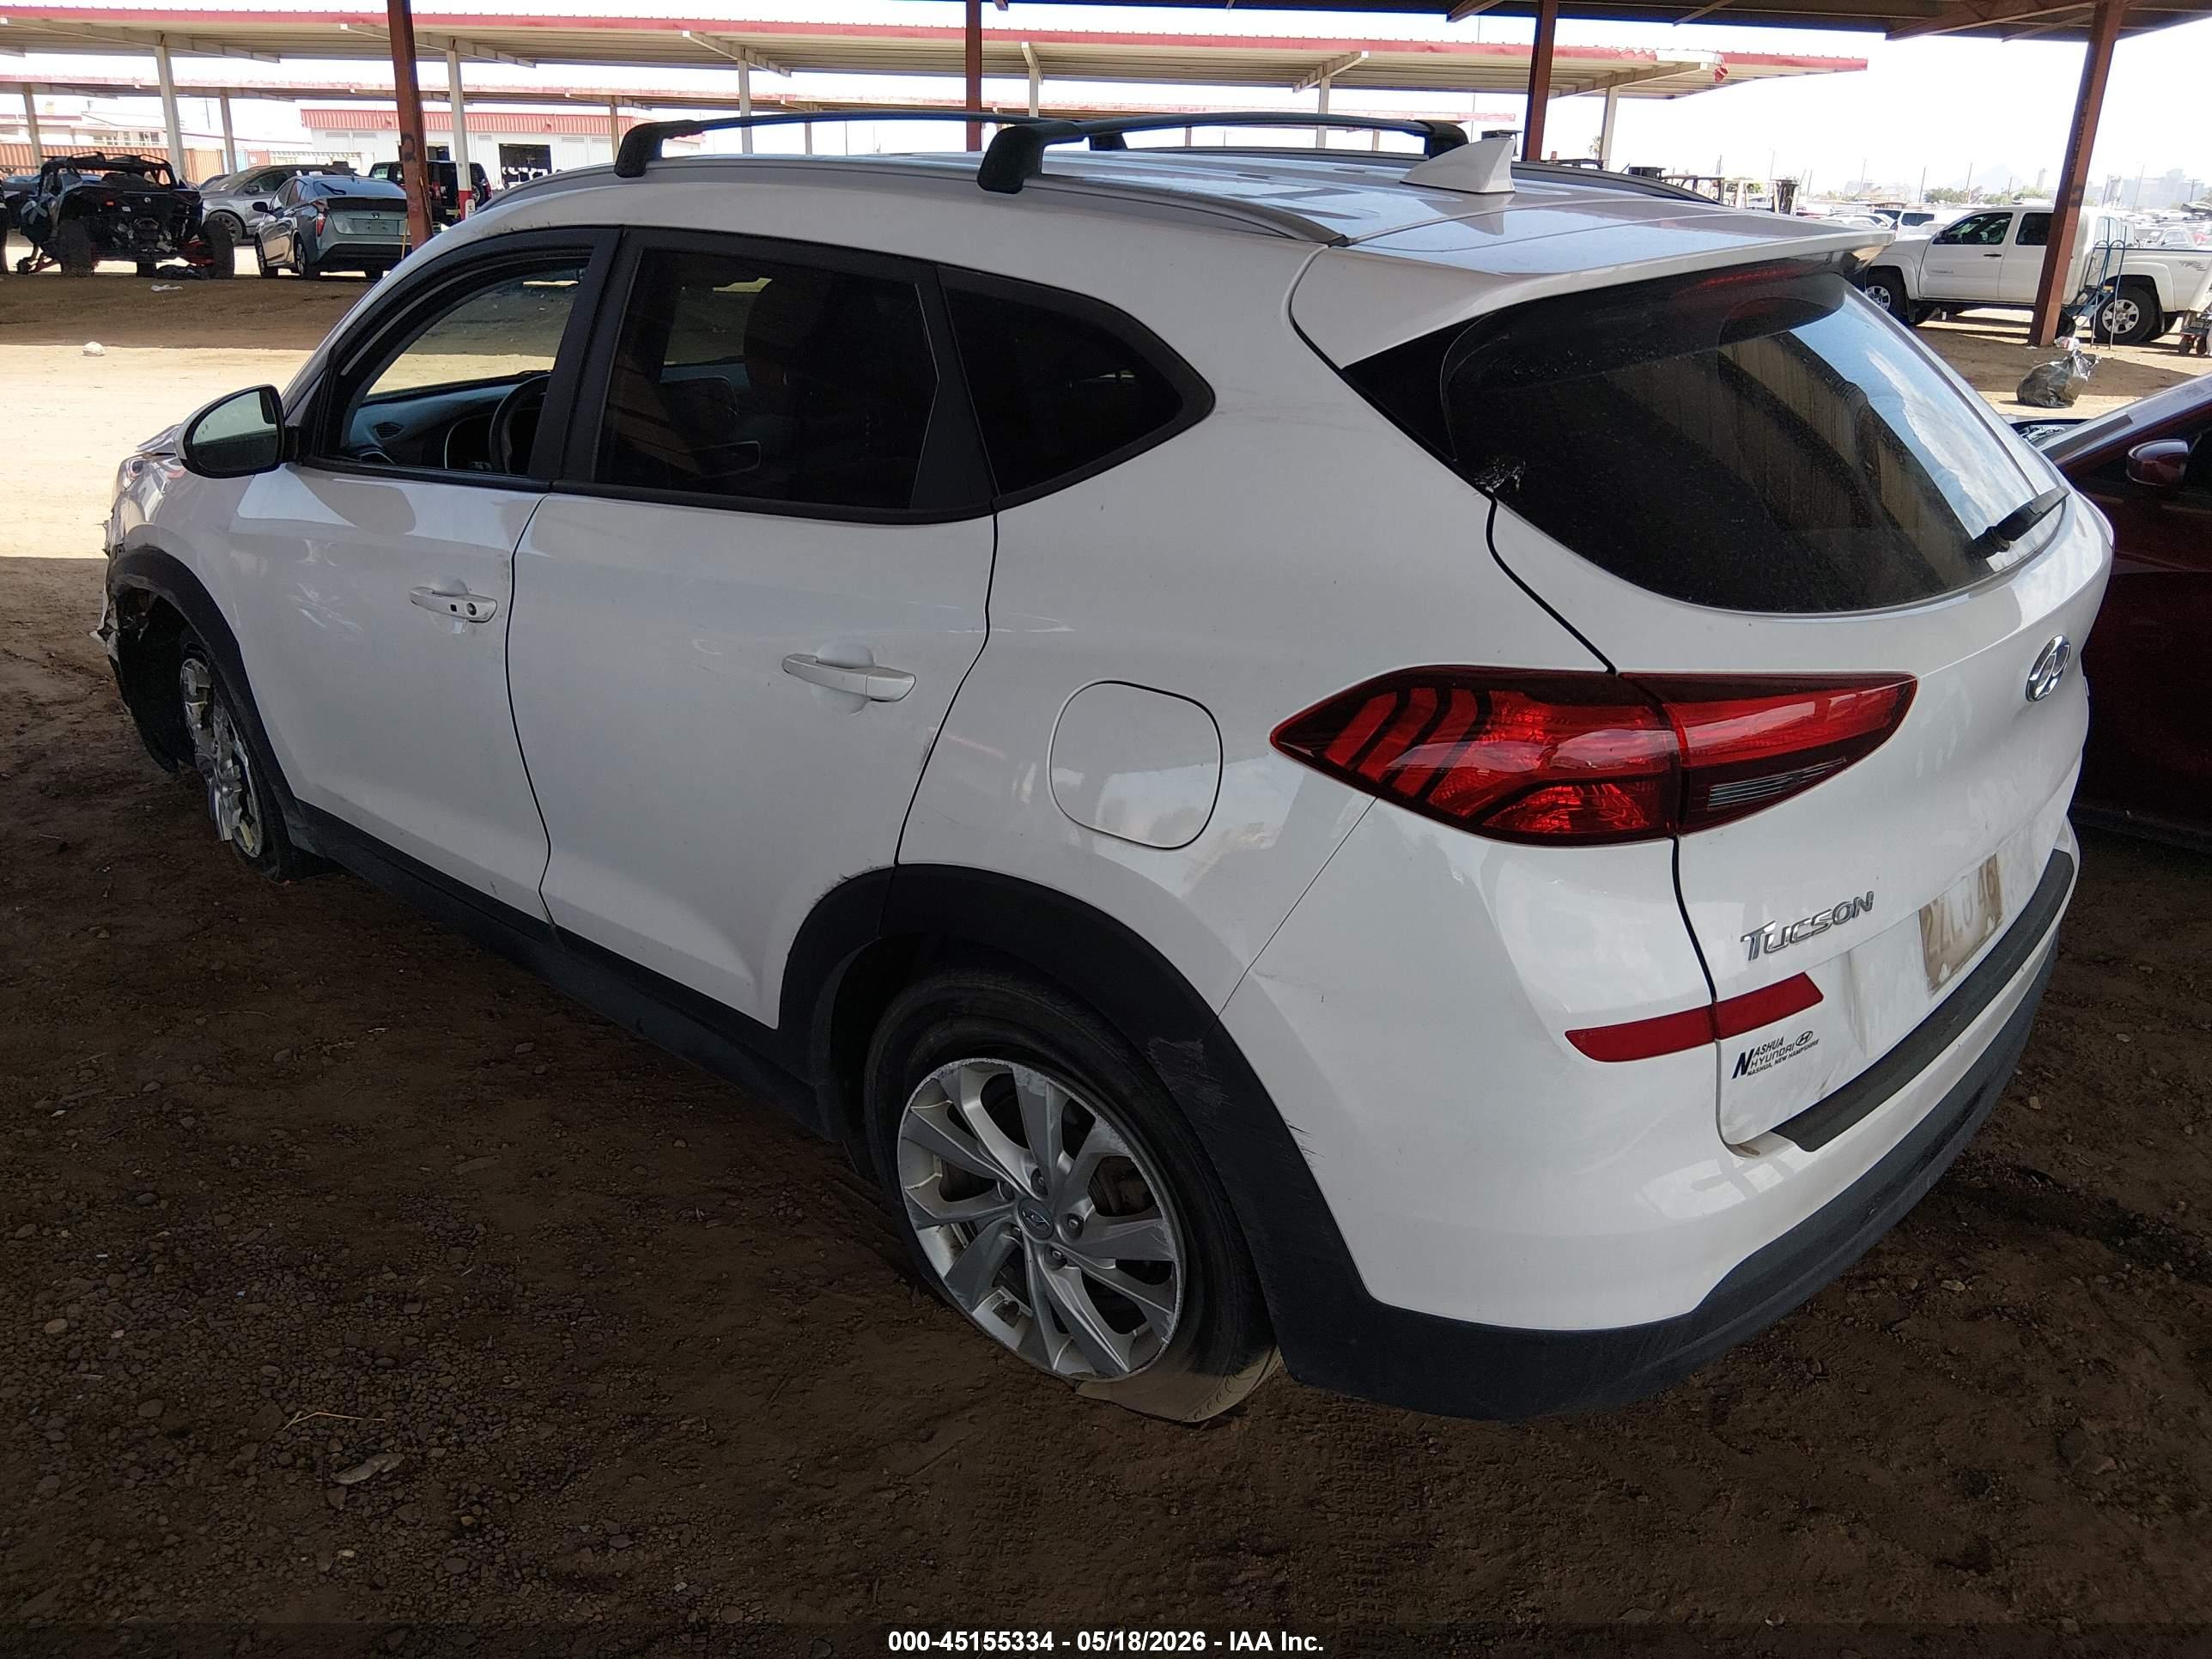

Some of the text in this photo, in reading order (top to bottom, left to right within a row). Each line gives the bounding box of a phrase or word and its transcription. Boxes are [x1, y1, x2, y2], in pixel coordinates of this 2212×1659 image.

[1731, 1036, 1784, 1079] NASHUA
[1751, 1044, 1795, 1069] HYUNDAI
[1774, 1056, 1787, 1065] NEW
[1788, 1038, 1820, 1058] HAMPSHIRE
